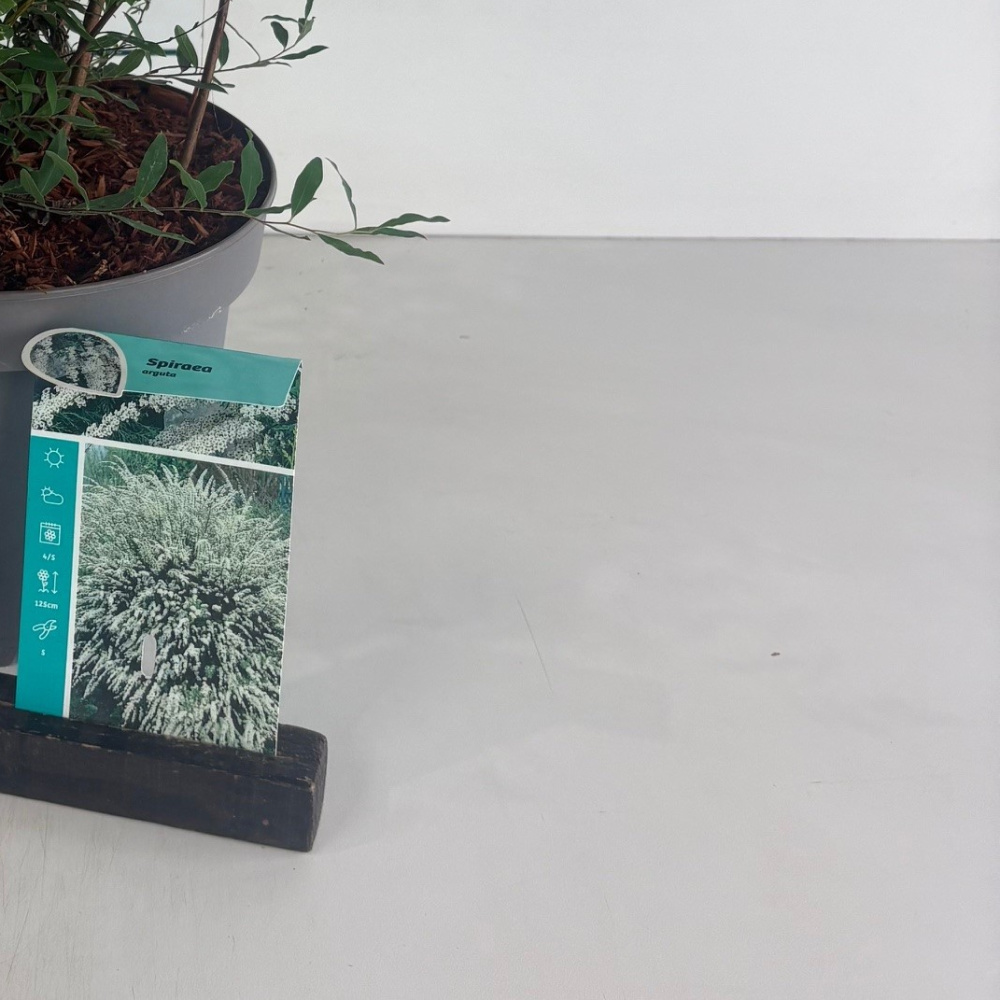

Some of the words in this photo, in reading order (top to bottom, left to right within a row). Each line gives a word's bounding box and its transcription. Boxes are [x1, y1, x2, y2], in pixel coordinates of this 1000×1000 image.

[146, 358, 212, 373] Spiraea
[142, 369, 177, 378] arguta
[34, 600, 59, 610] 125cm
